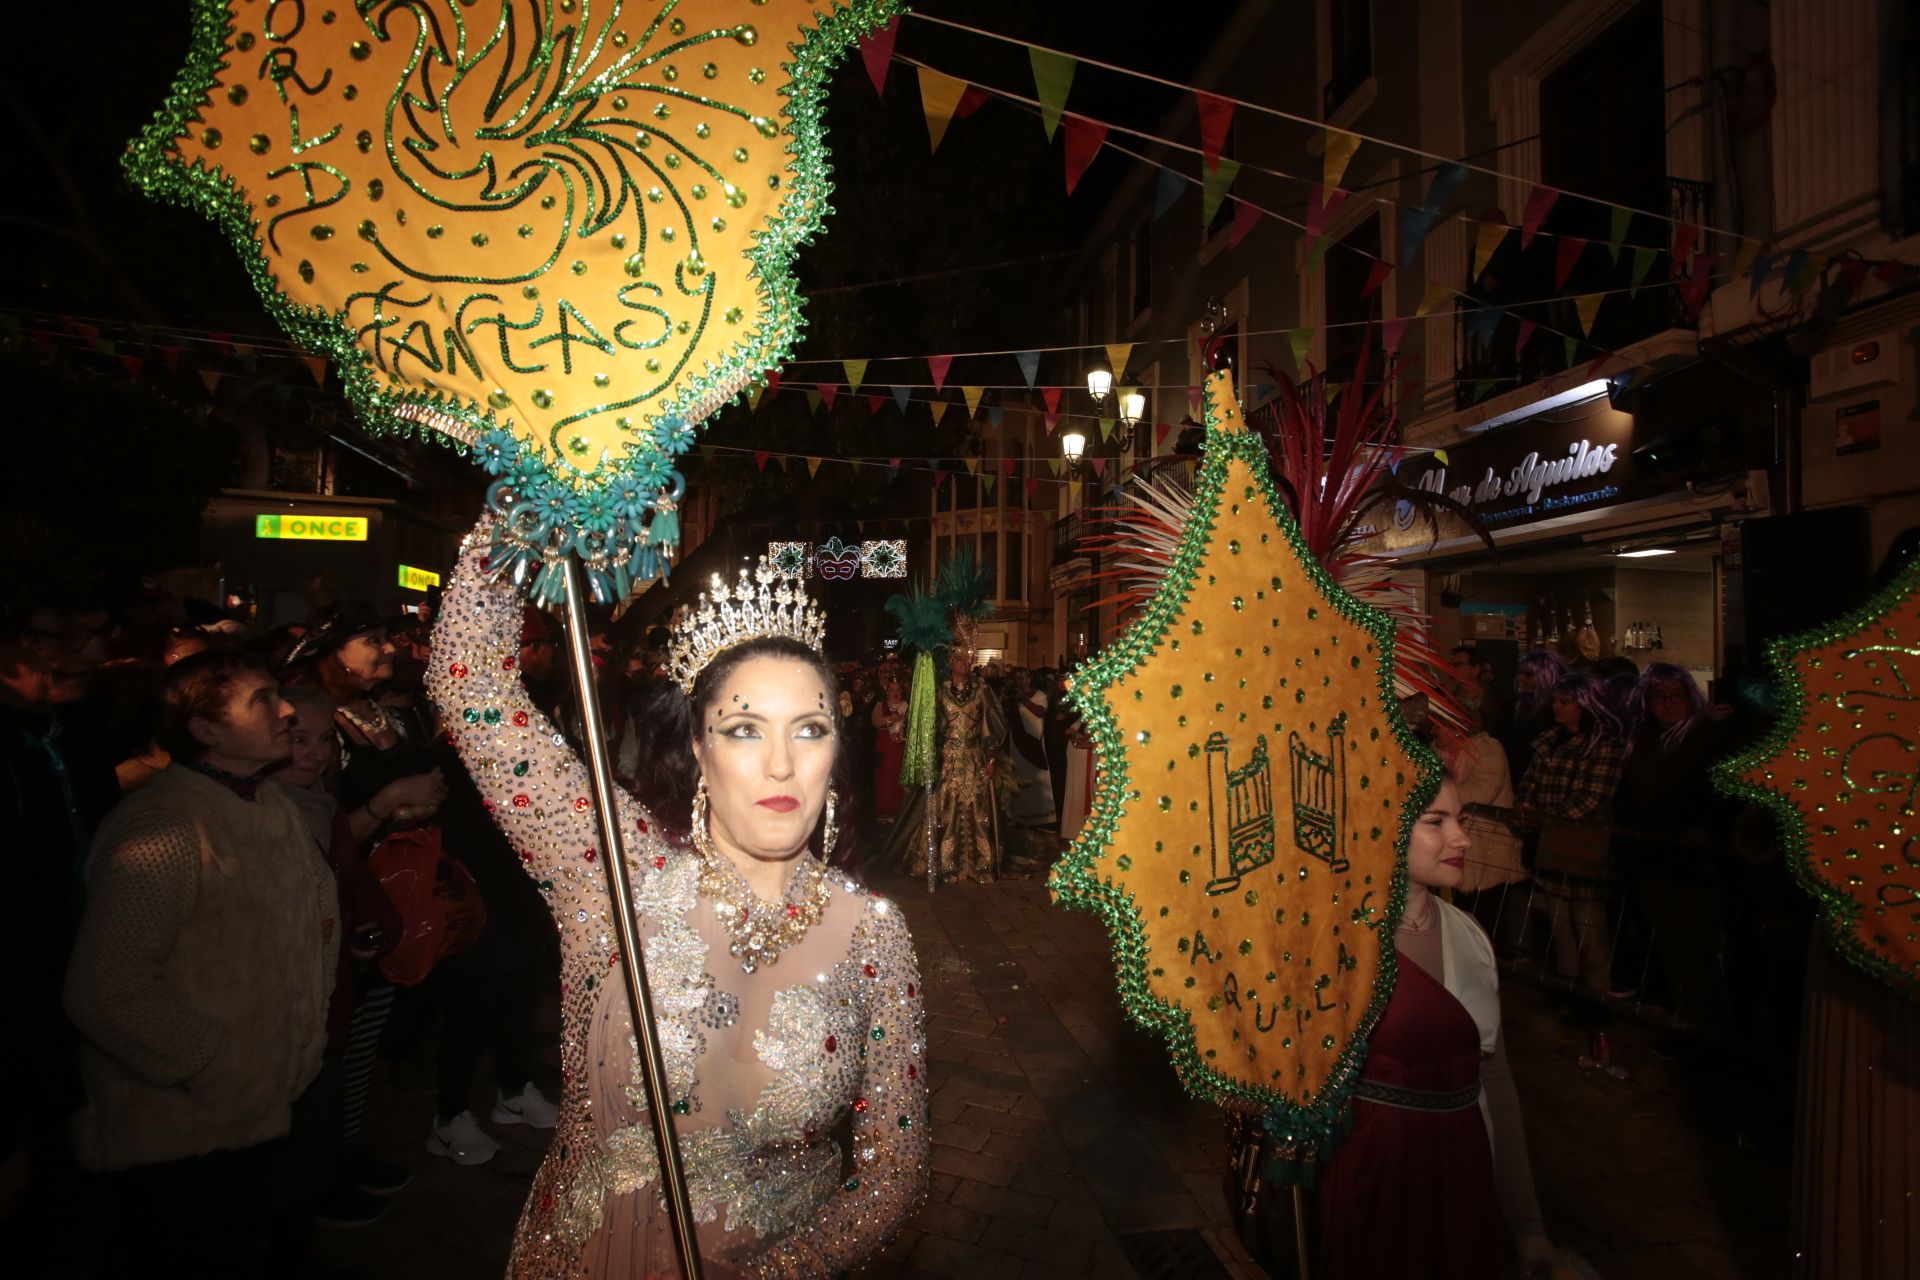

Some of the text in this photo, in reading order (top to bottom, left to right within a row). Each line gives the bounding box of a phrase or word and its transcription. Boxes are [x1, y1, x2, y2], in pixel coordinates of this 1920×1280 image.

[346, 261, 715, 479] FANTASY
[1475, 467, 1501, 504] de
[289, 520, 358, 537] ONCE
[411, 570, 436, 586] ONCE
